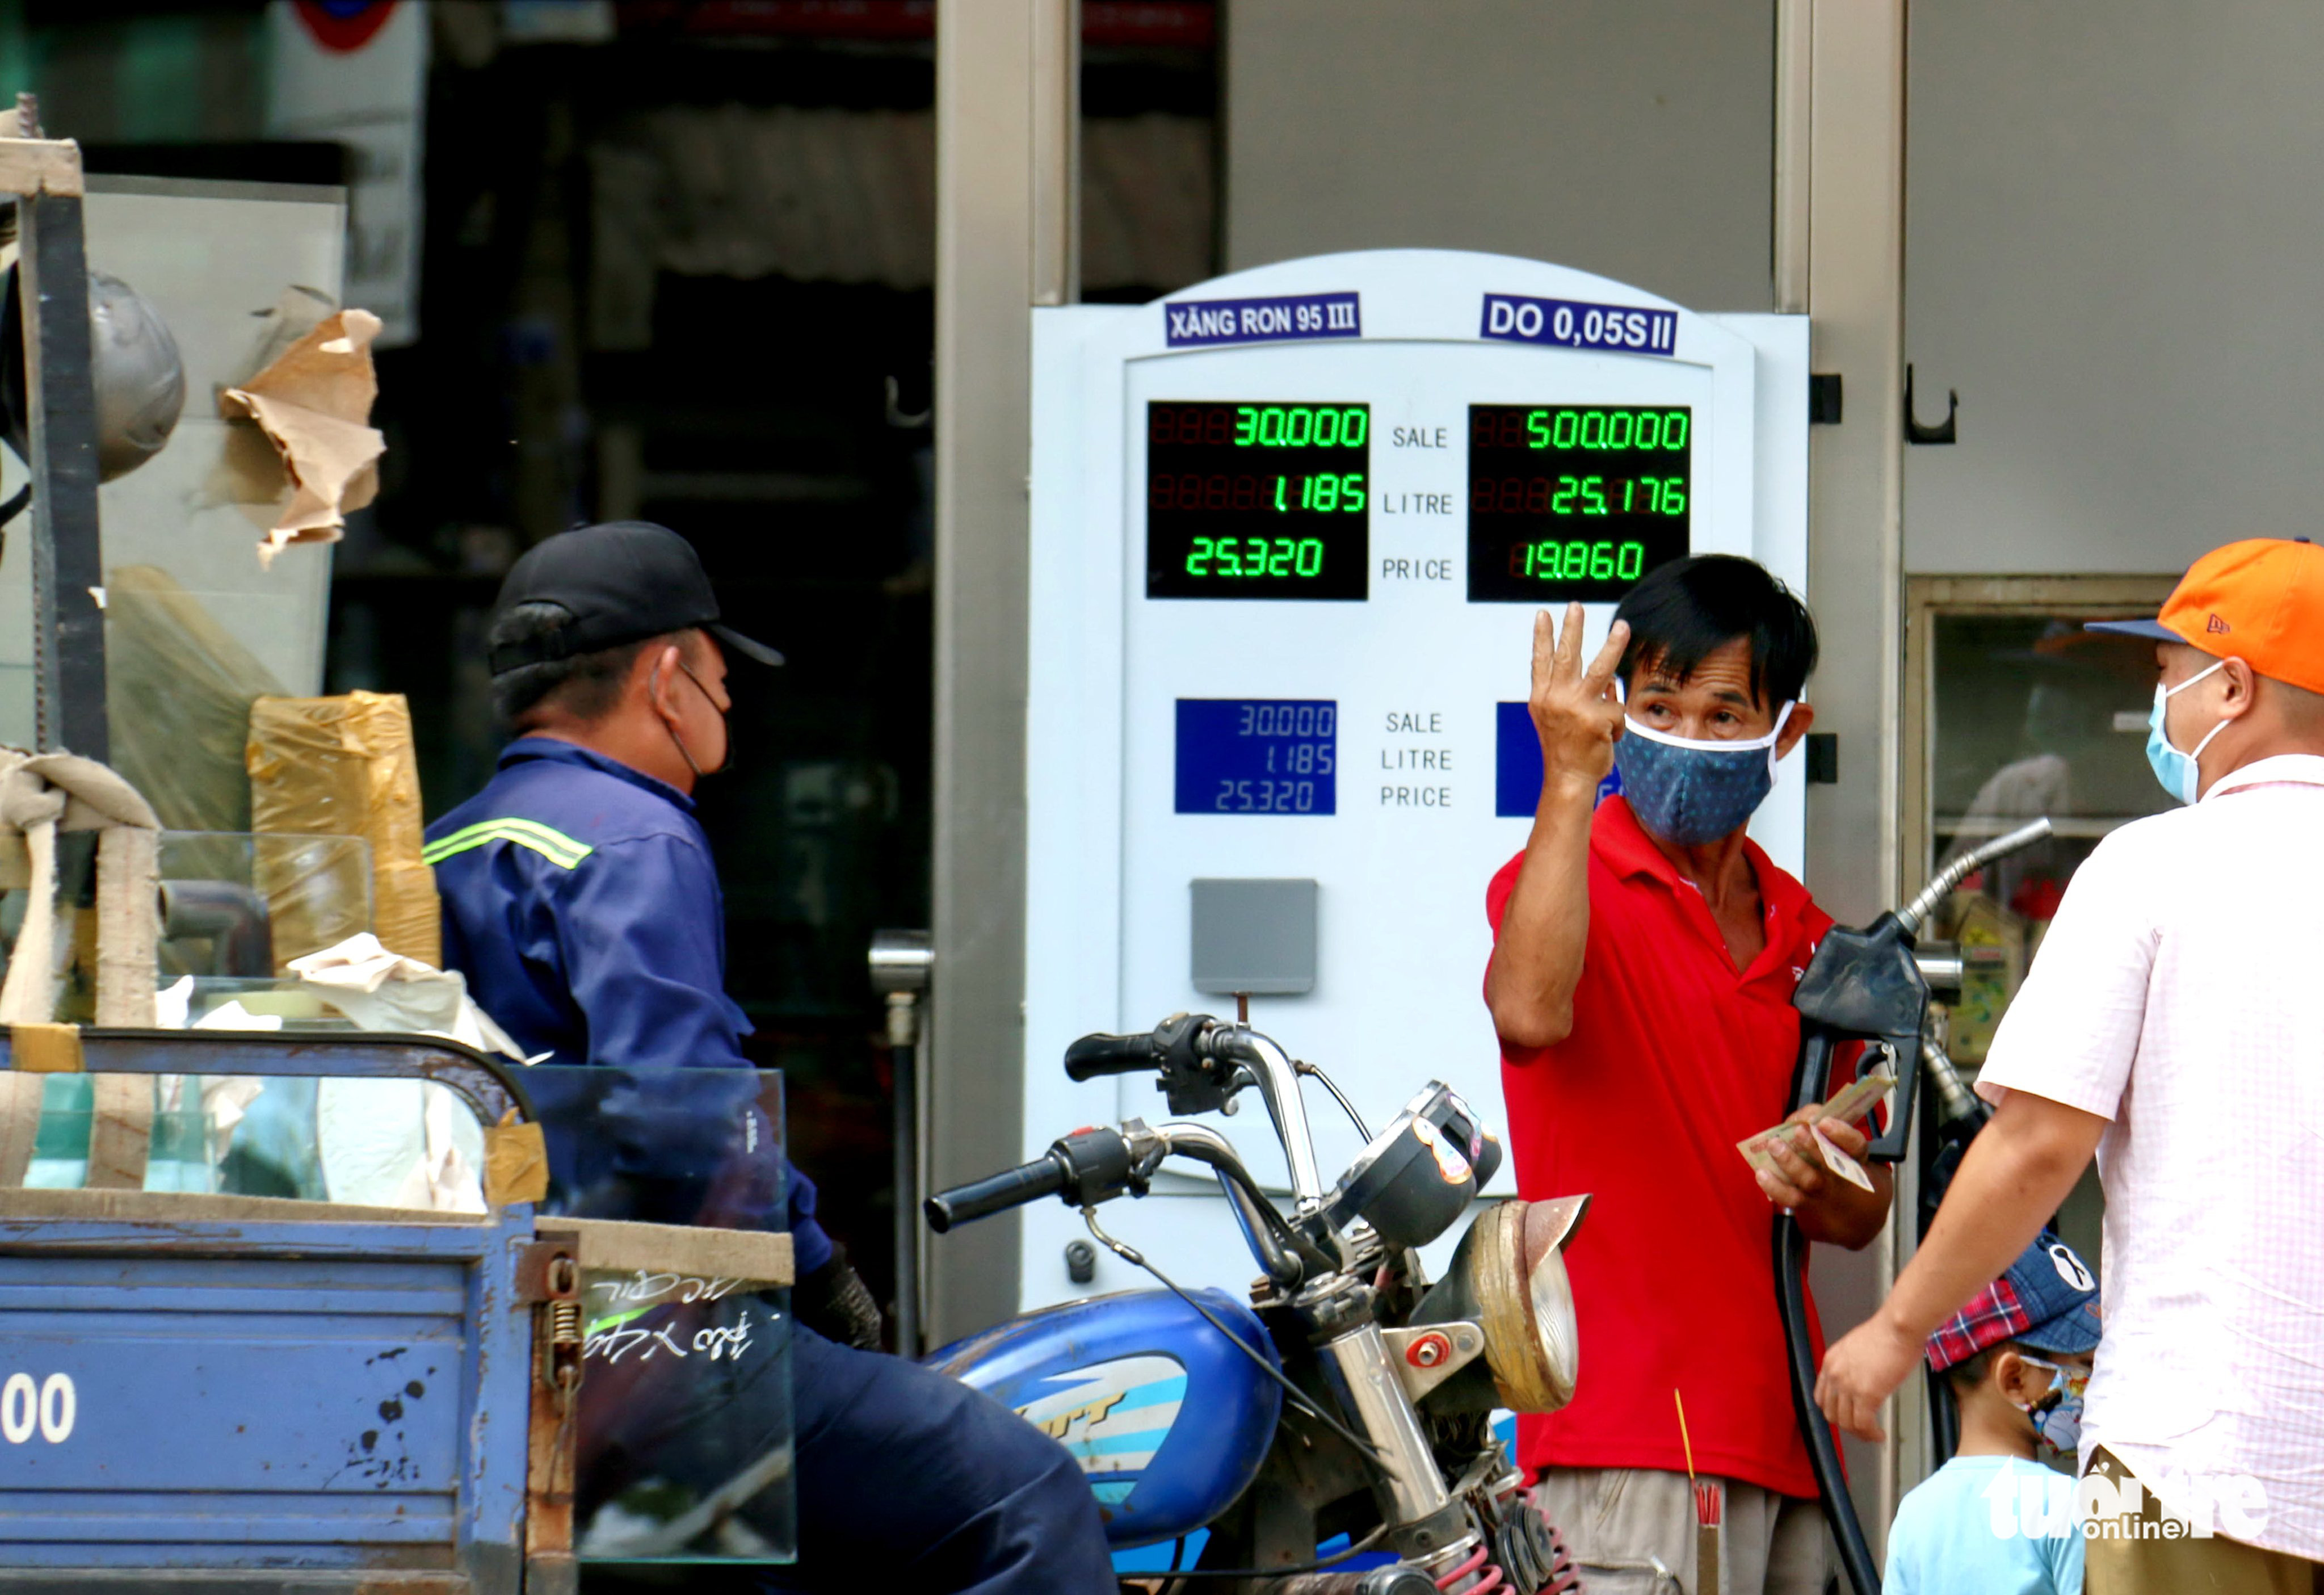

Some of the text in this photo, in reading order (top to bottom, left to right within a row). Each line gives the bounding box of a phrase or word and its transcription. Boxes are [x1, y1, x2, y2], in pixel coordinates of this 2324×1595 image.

[1170, 302, 1356, 339] XĂNG RON 95 III
[1489, 300, 1544, 337] DO
[1234, 406, 1368, 447] 30.000
[1392, 427, 1447, 448] SALE
[1527, 410, 1688, 450] 500.000
[1275, 473, 1365, 512] 1.185
[1383, 493, 1453, 514] LITRE
[1552, 476, 1686, 515] 25.176
[1186, 536, 1324, 576] 25.320
[1382, 559, 1452, 581] PRICE
[1525, 540, 1645, 580] 19.860
[1385, 712, 1443, 733] SALE
[1381, 749, 1453, 770] LITRE
[1380, 786, 1452, 807] PRICE
